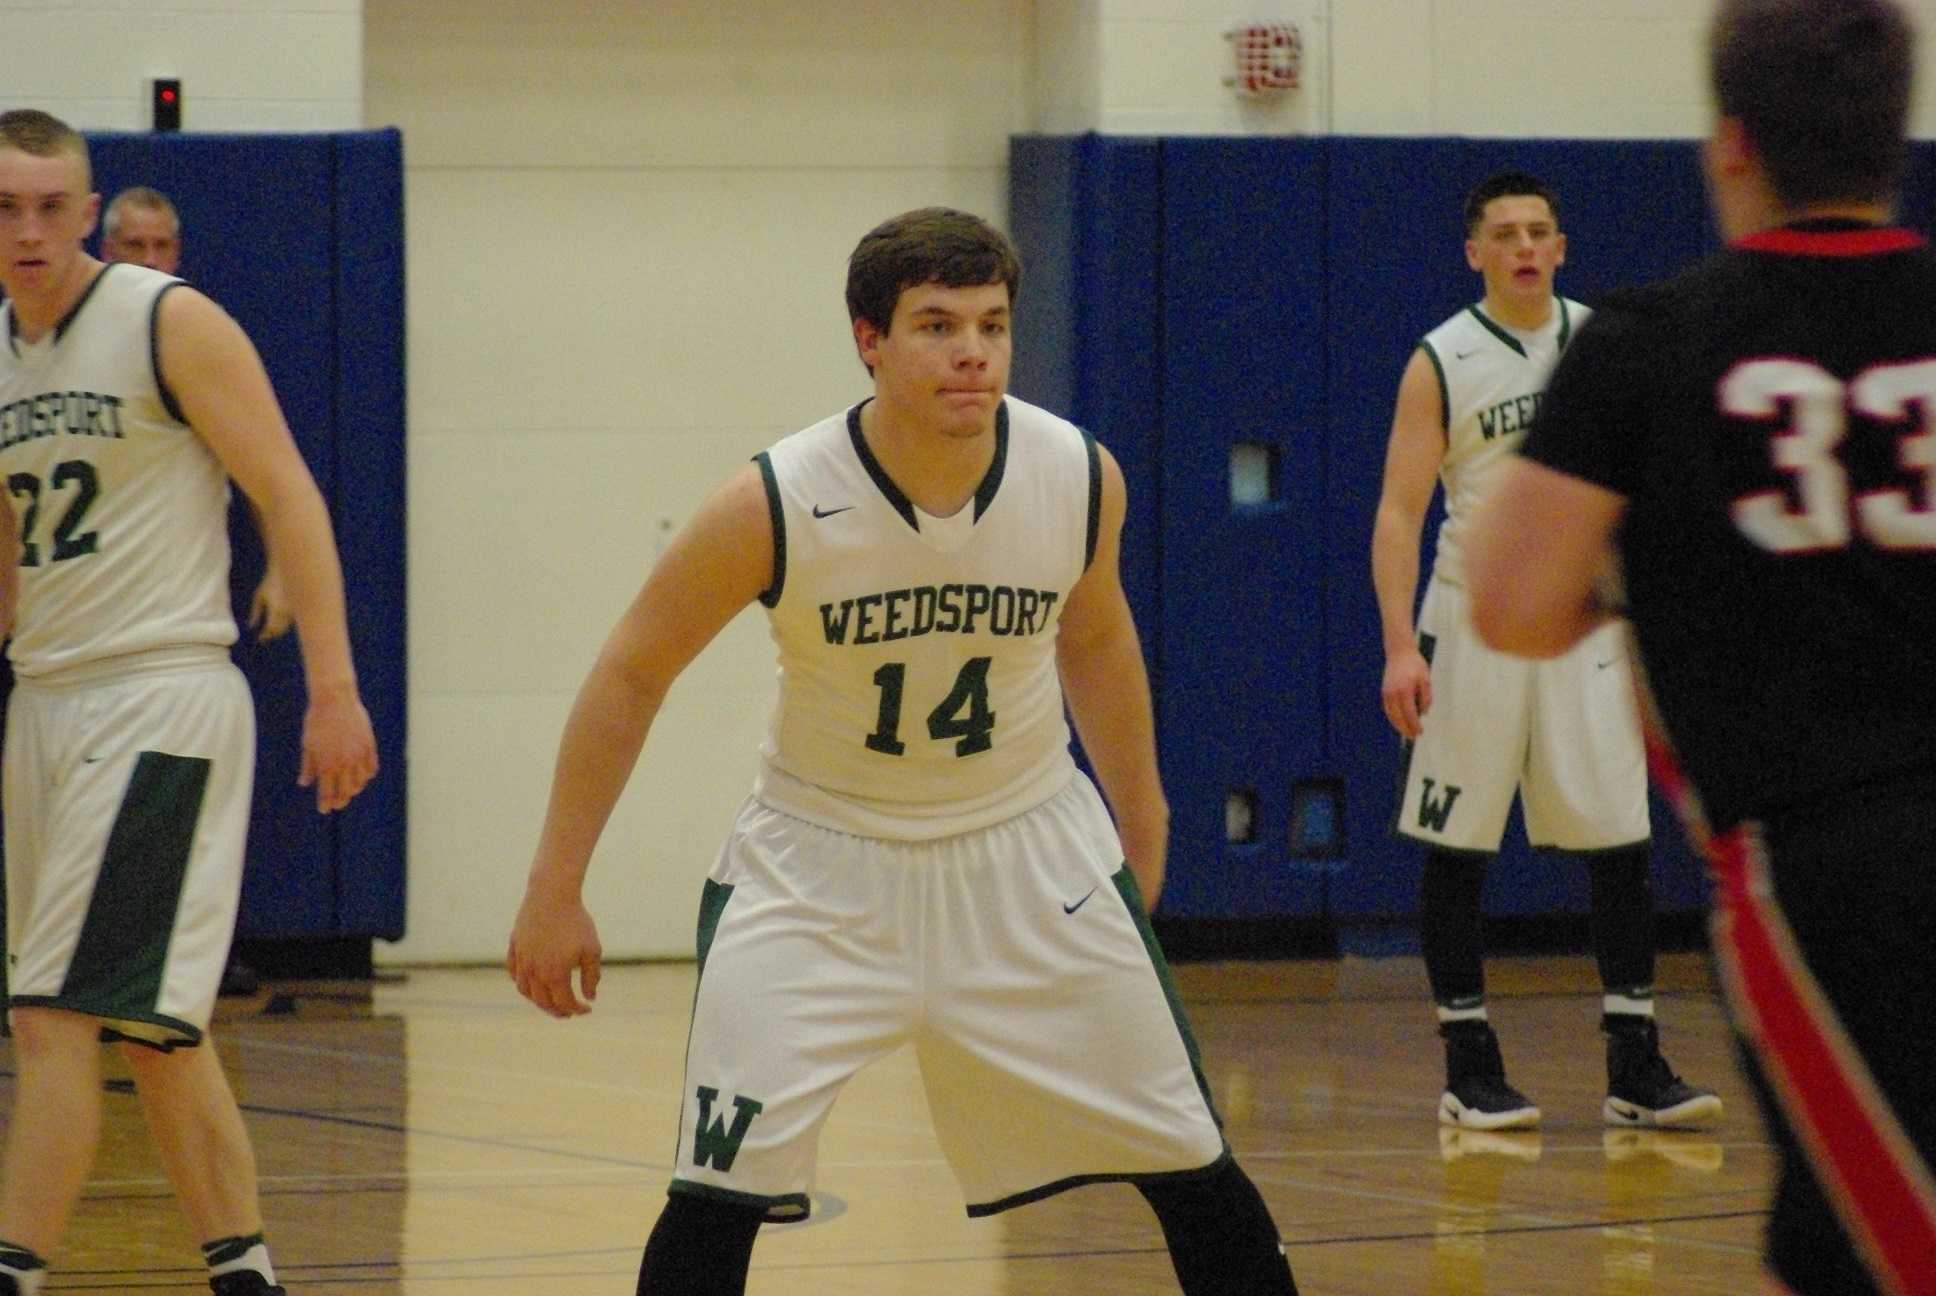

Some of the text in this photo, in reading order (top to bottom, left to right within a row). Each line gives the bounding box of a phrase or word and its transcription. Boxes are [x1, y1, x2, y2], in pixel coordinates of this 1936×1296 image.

[1716, 354, 1936, 554] 33
[7, 459, 98, 567] 22
[819, 583, 1058, 645] WEEDSPORT
[865, 656, 996, 758] 14
[1418, 777, 1462, 832] W
[693, 1085, 763, 1173] W
